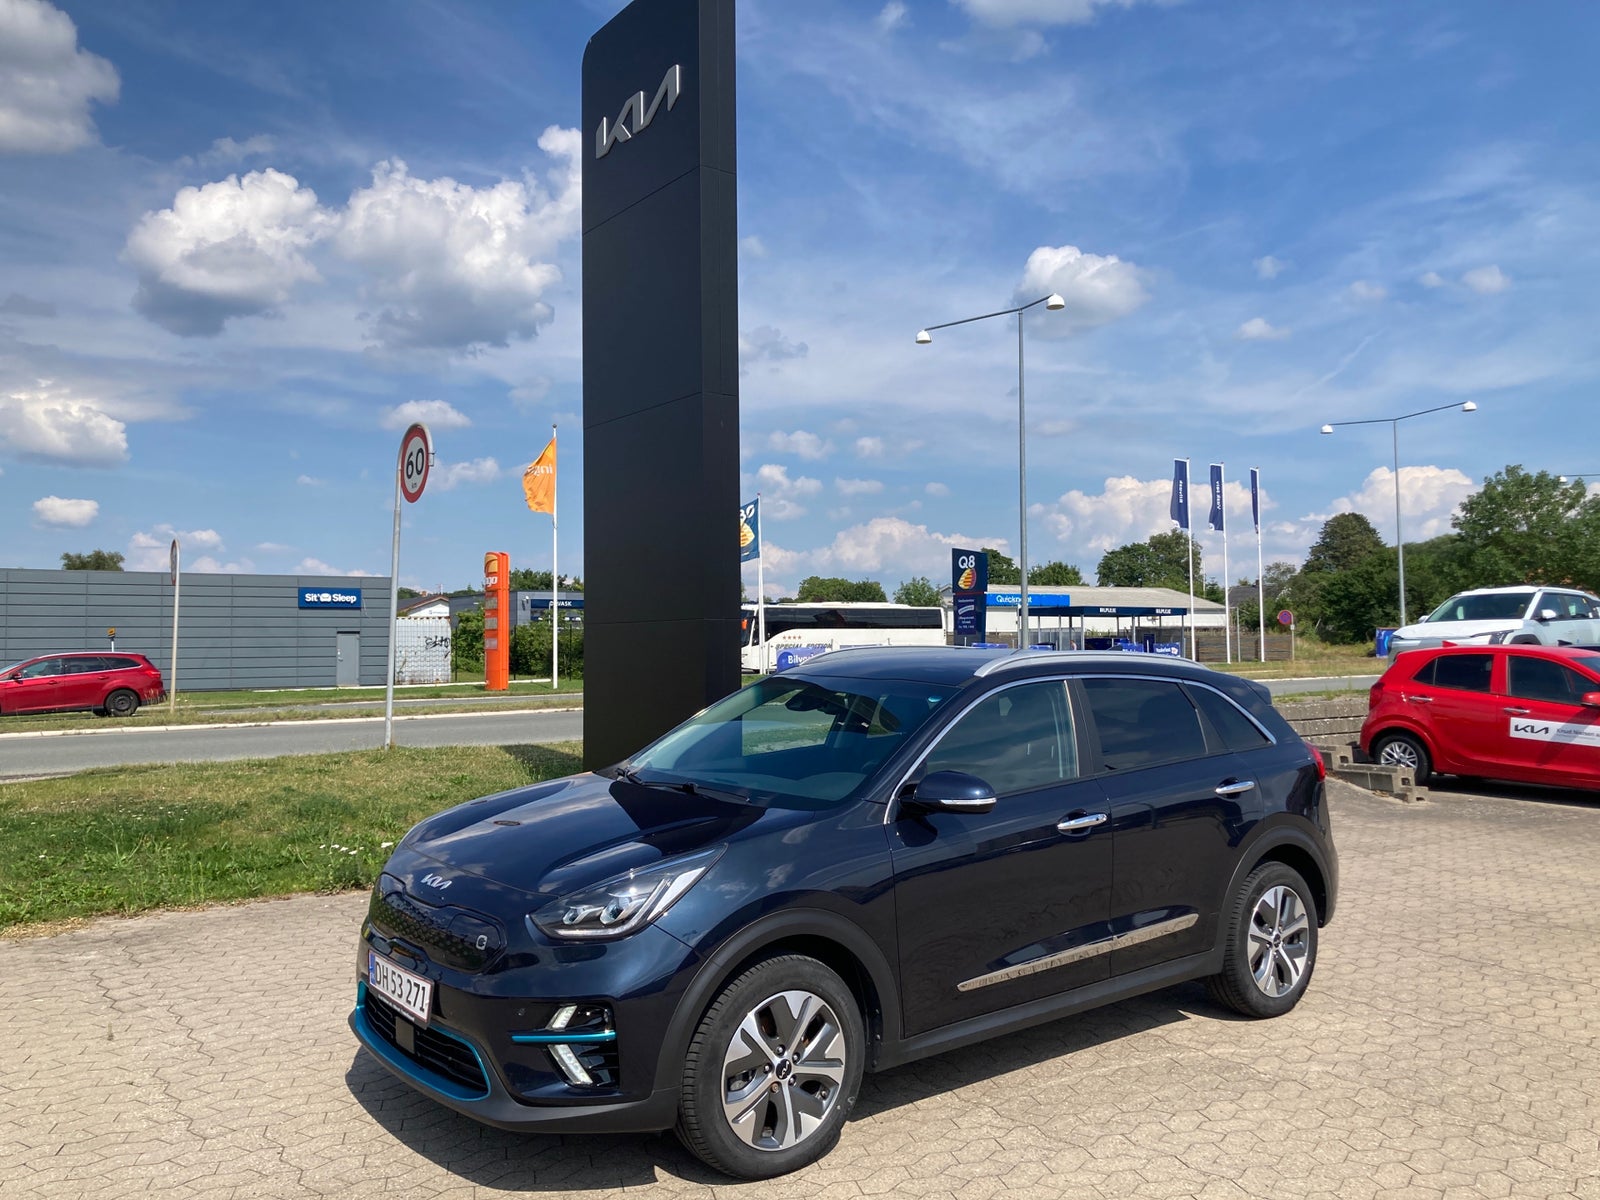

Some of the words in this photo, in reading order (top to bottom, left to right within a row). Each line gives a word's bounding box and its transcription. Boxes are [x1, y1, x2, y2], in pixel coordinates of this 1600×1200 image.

[595, 64, 680, 160] KIA
[406, 447, 425, 480] 60
[958, 555, 976, 569] Q8
[332, 593, 357, 604] Sleep
[996, 595, 1032, 604] Quickpt
[1514, 724, 1549, 734] KIA
[420, 873, 452, 890] KIA
[375, 961, 389, 990] DH
[391, 970, 404, 998] 53
[406, 978, 426, 1013] 271
